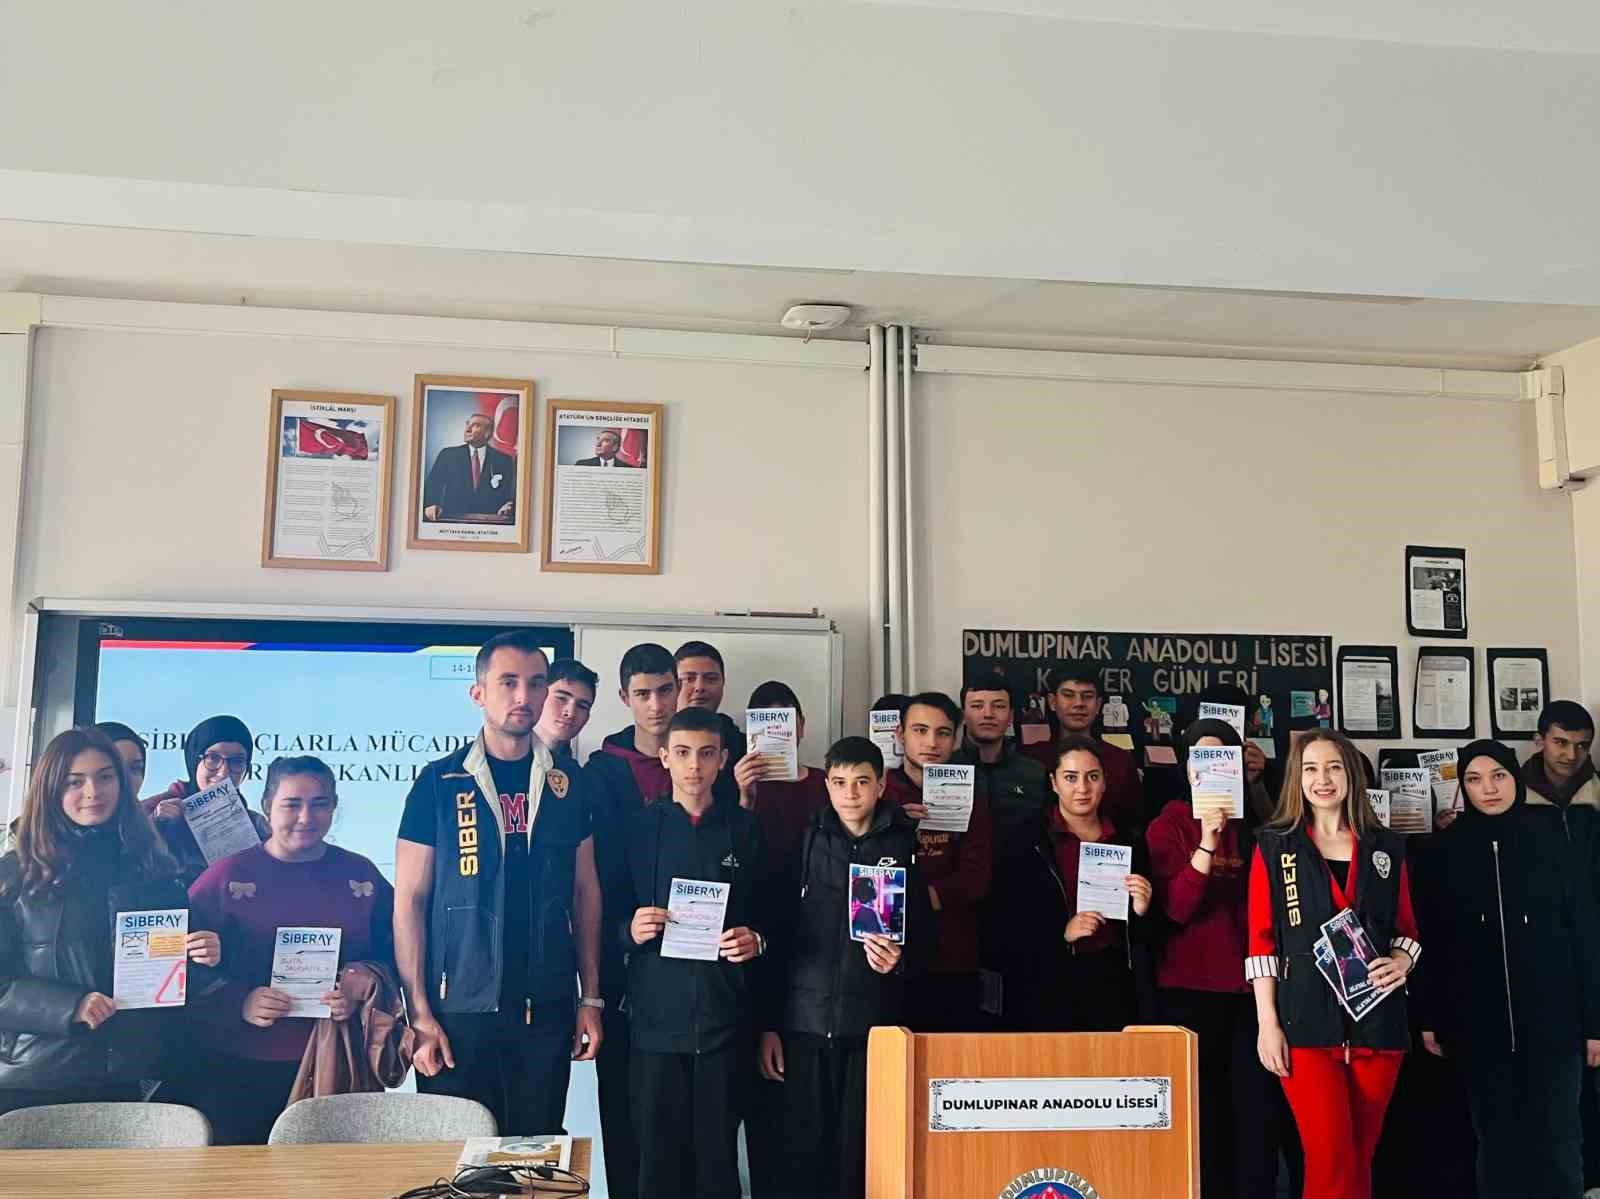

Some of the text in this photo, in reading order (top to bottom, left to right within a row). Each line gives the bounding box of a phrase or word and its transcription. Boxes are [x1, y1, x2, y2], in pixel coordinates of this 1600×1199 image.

[963, 631, 1327, 667] DUMLUPINAR ANADOLU LİSESİ
[254, 733, 358, 754] ÇLARLA
[942, 1094, 1159, 1111] DUMLUPINAR ANADOLU LİSESİ
